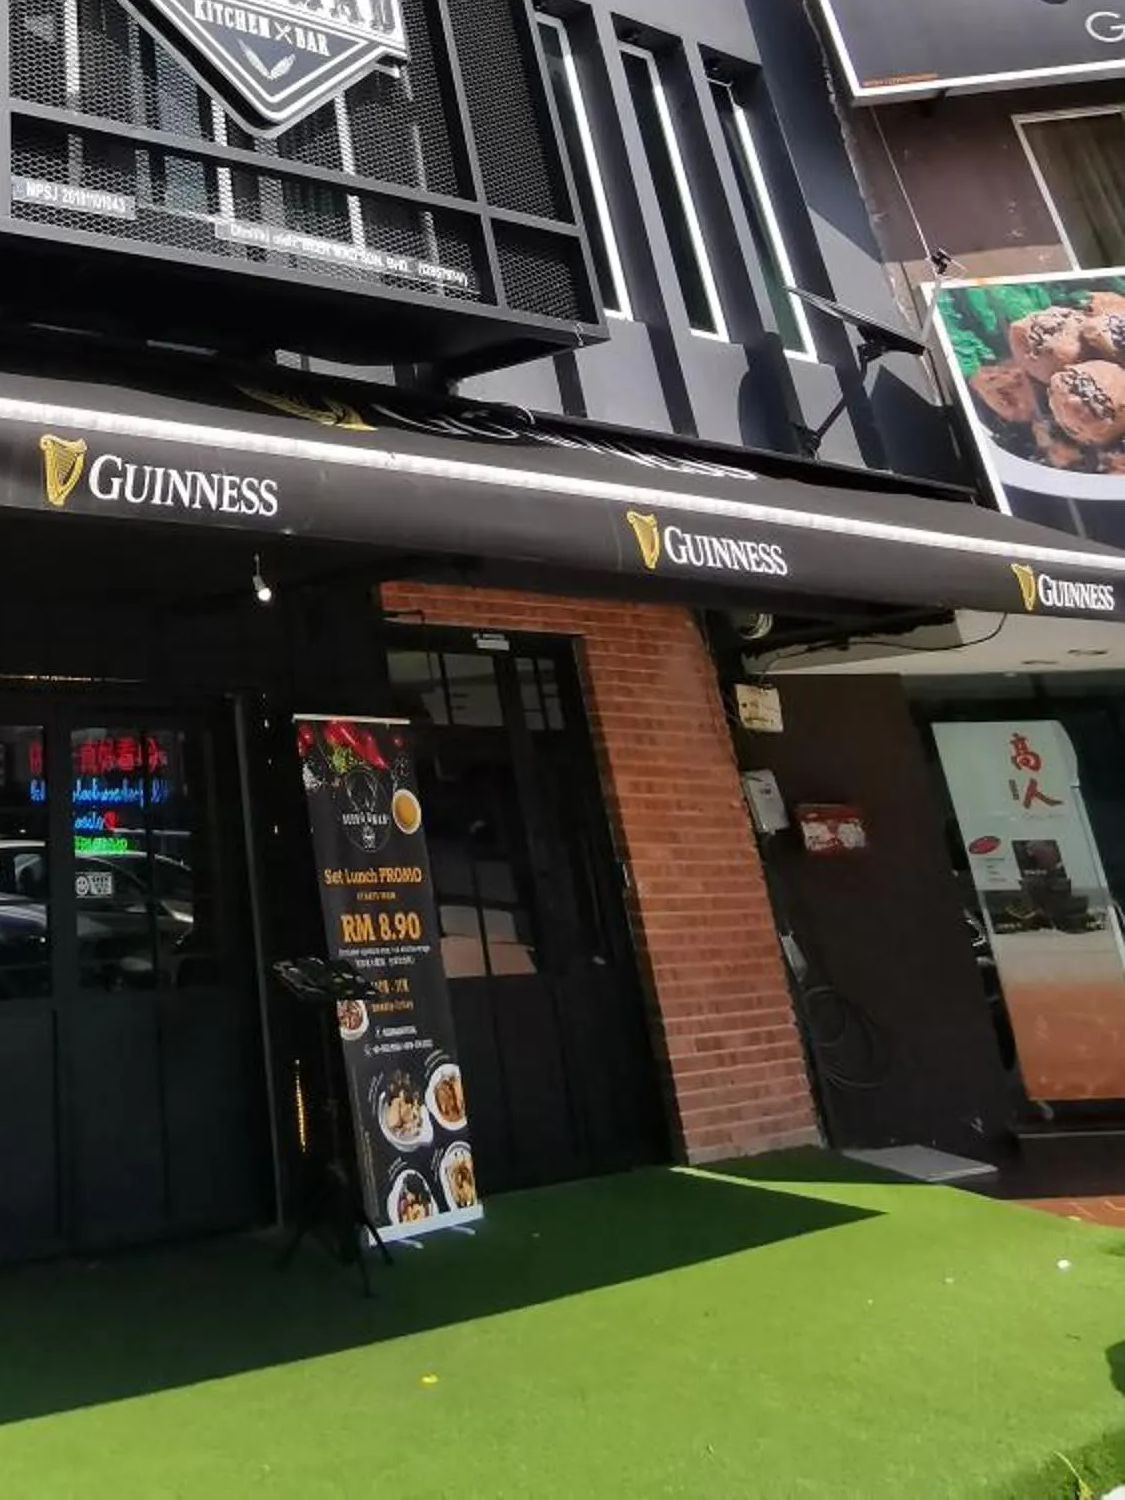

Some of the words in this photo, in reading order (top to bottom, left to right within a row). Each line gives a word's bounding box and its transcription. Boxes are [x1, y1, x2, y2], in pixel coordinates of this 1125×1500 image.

[295, 24, 331, 57] BAR
[88, 454, 279, 517] GUINNESS
[664, 526, 788, 577] GUINNESS
[1037, 573, 1115, 611] GUINNESS
[324, 867, 343, 886] Set
[345, 866, 377, 885] Lunch
[378, 866, 422, 885] PROMO
[340, 913, 376, 943] RM
[378, 911, 422, 941] 8.90
